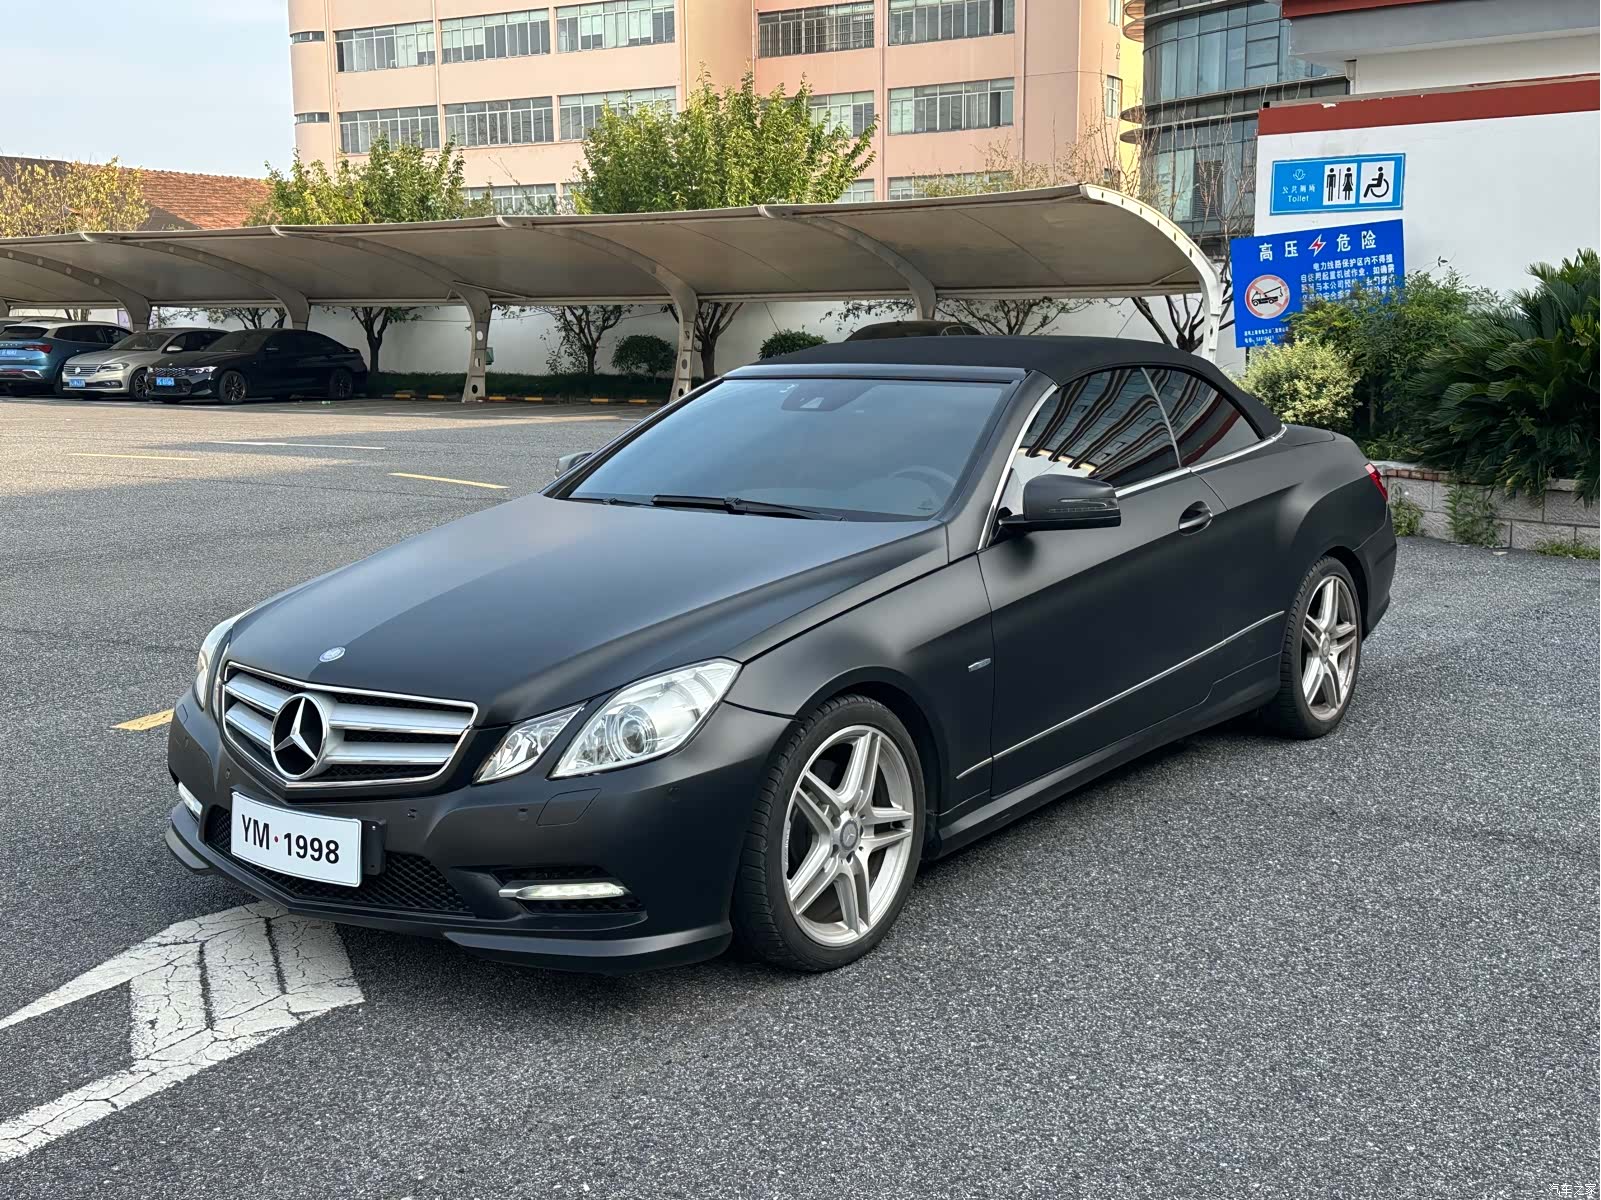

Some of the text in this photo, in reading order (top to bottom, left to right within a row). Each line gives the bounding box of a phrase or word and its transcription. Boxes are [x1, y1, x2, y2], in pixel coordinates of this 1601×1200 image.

[1288, 195, 1309, 203] Toilet
[1258, 229, 1377, 262] 高压 危险
